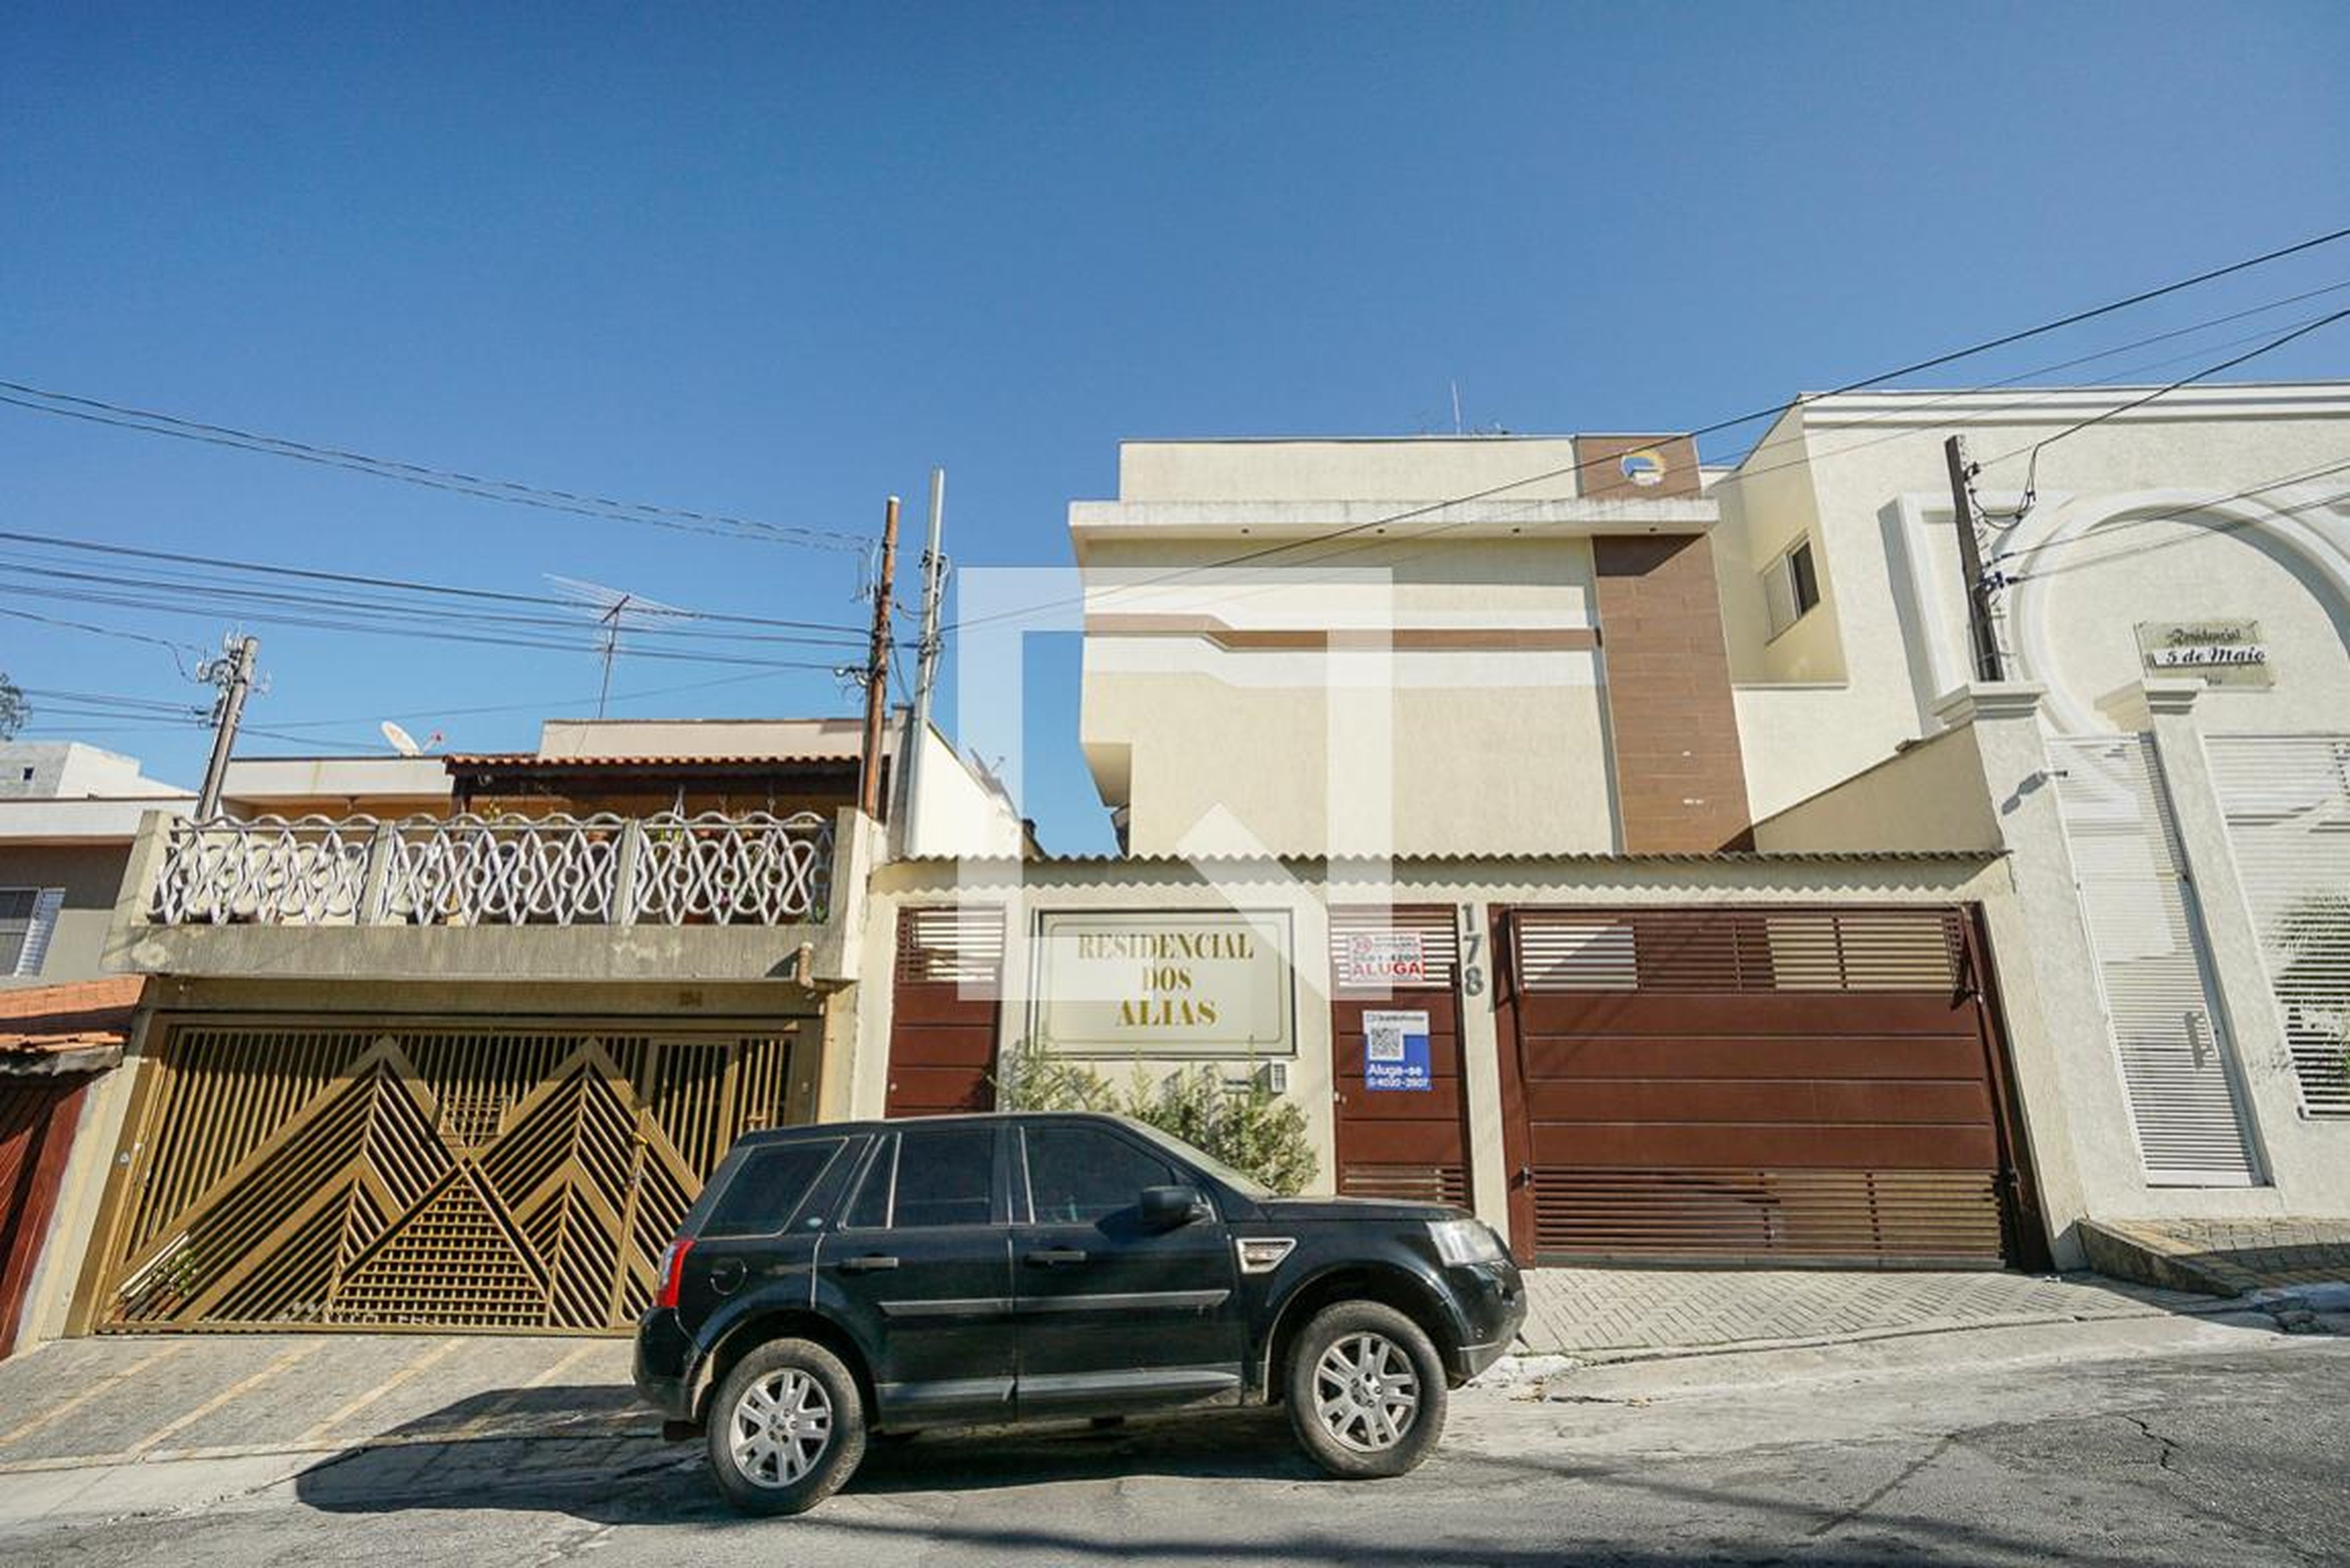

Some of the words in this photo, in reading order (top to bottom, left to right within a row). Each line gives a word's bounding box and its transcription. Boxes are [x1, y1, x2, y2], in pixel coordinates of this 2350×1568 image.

[2166, 651, 2177, 663] 5
[2182, 649, 2204, 663] de
[2207, 646, 2266, 663] Maio
[1078, 933, 1254, 959] RESIDENCIAL
[1143, 966, 1192, 991] DOS
[1352, 962, 1420, 976] ALUGA
[1116, 1000, 1217, 1026] ALIAS
[1368, 1063, 1423, 1079] Aluga-se
